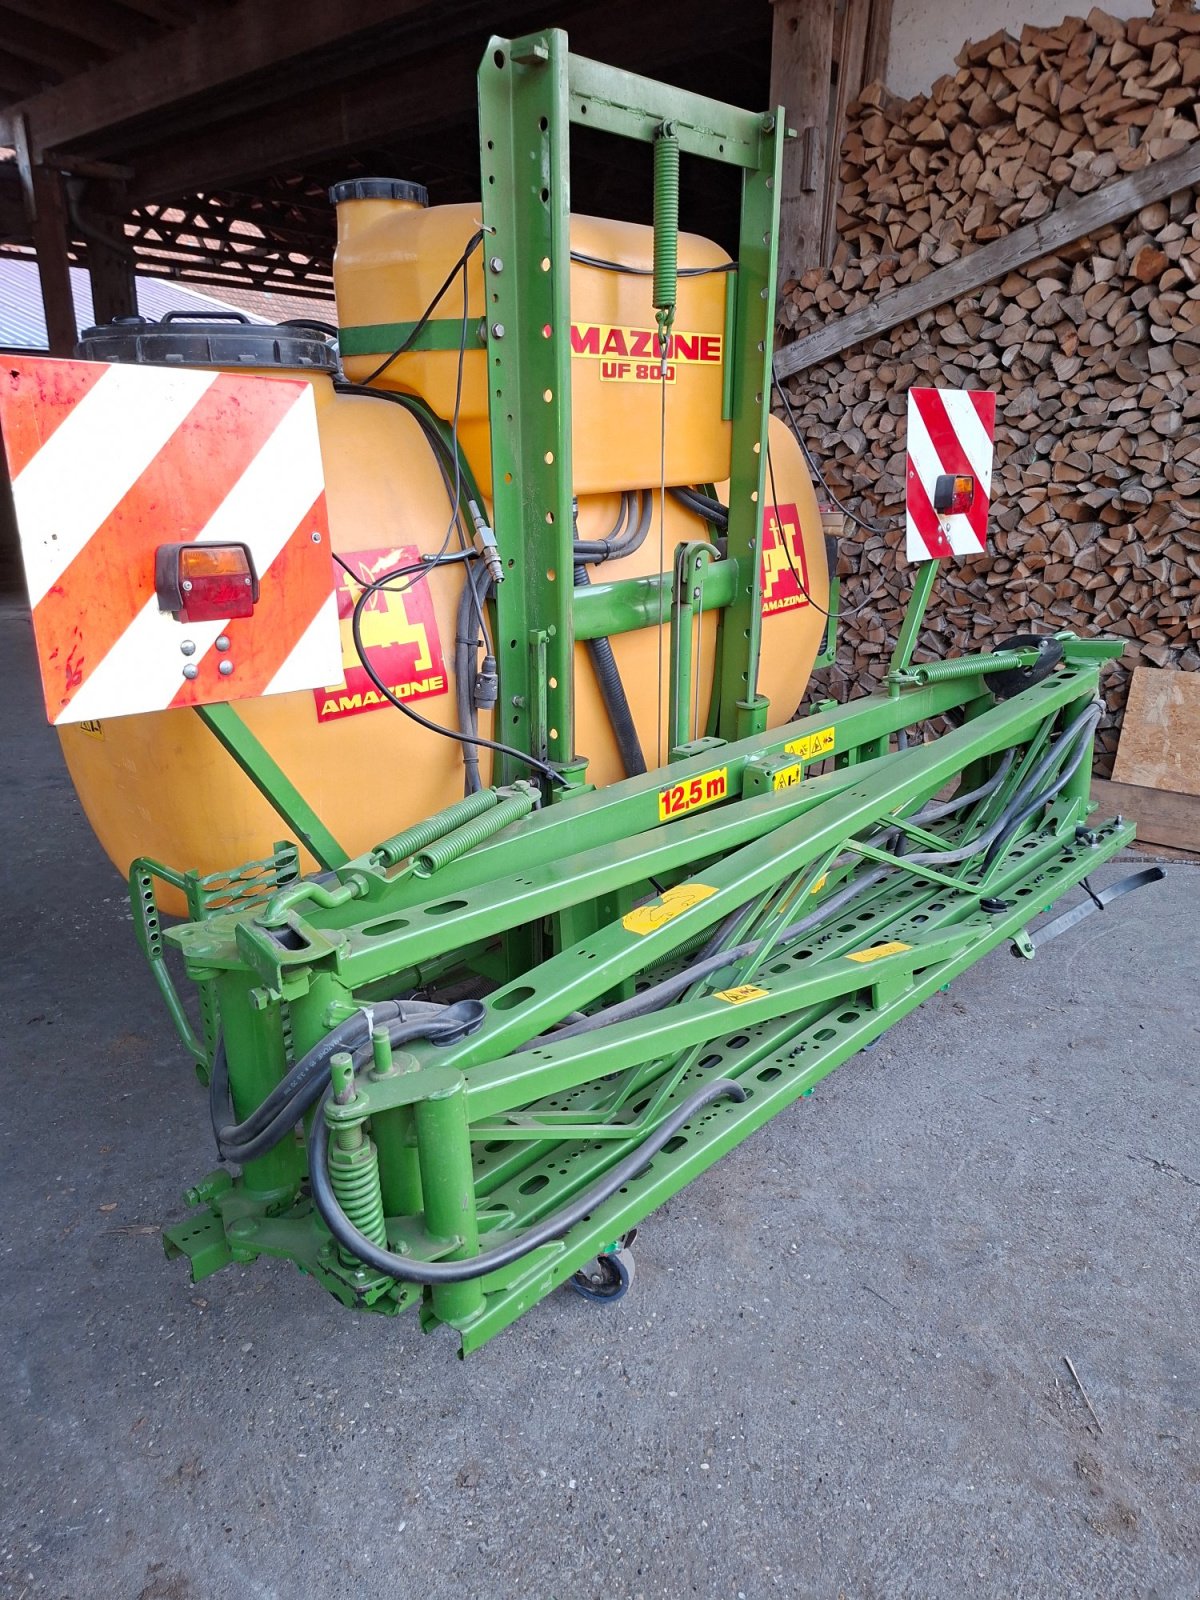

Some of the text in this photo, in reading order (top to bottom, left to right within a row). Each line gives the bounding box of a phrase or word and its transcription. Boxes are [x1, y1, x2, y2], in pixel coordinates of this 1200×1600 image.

[571, 325, 721, 361] MAZONE
[602, 362, 675, 381] UF 800
[762, 593, 808, 612] AMAZONE
[662, 776, 725, 815] 12,5 m
